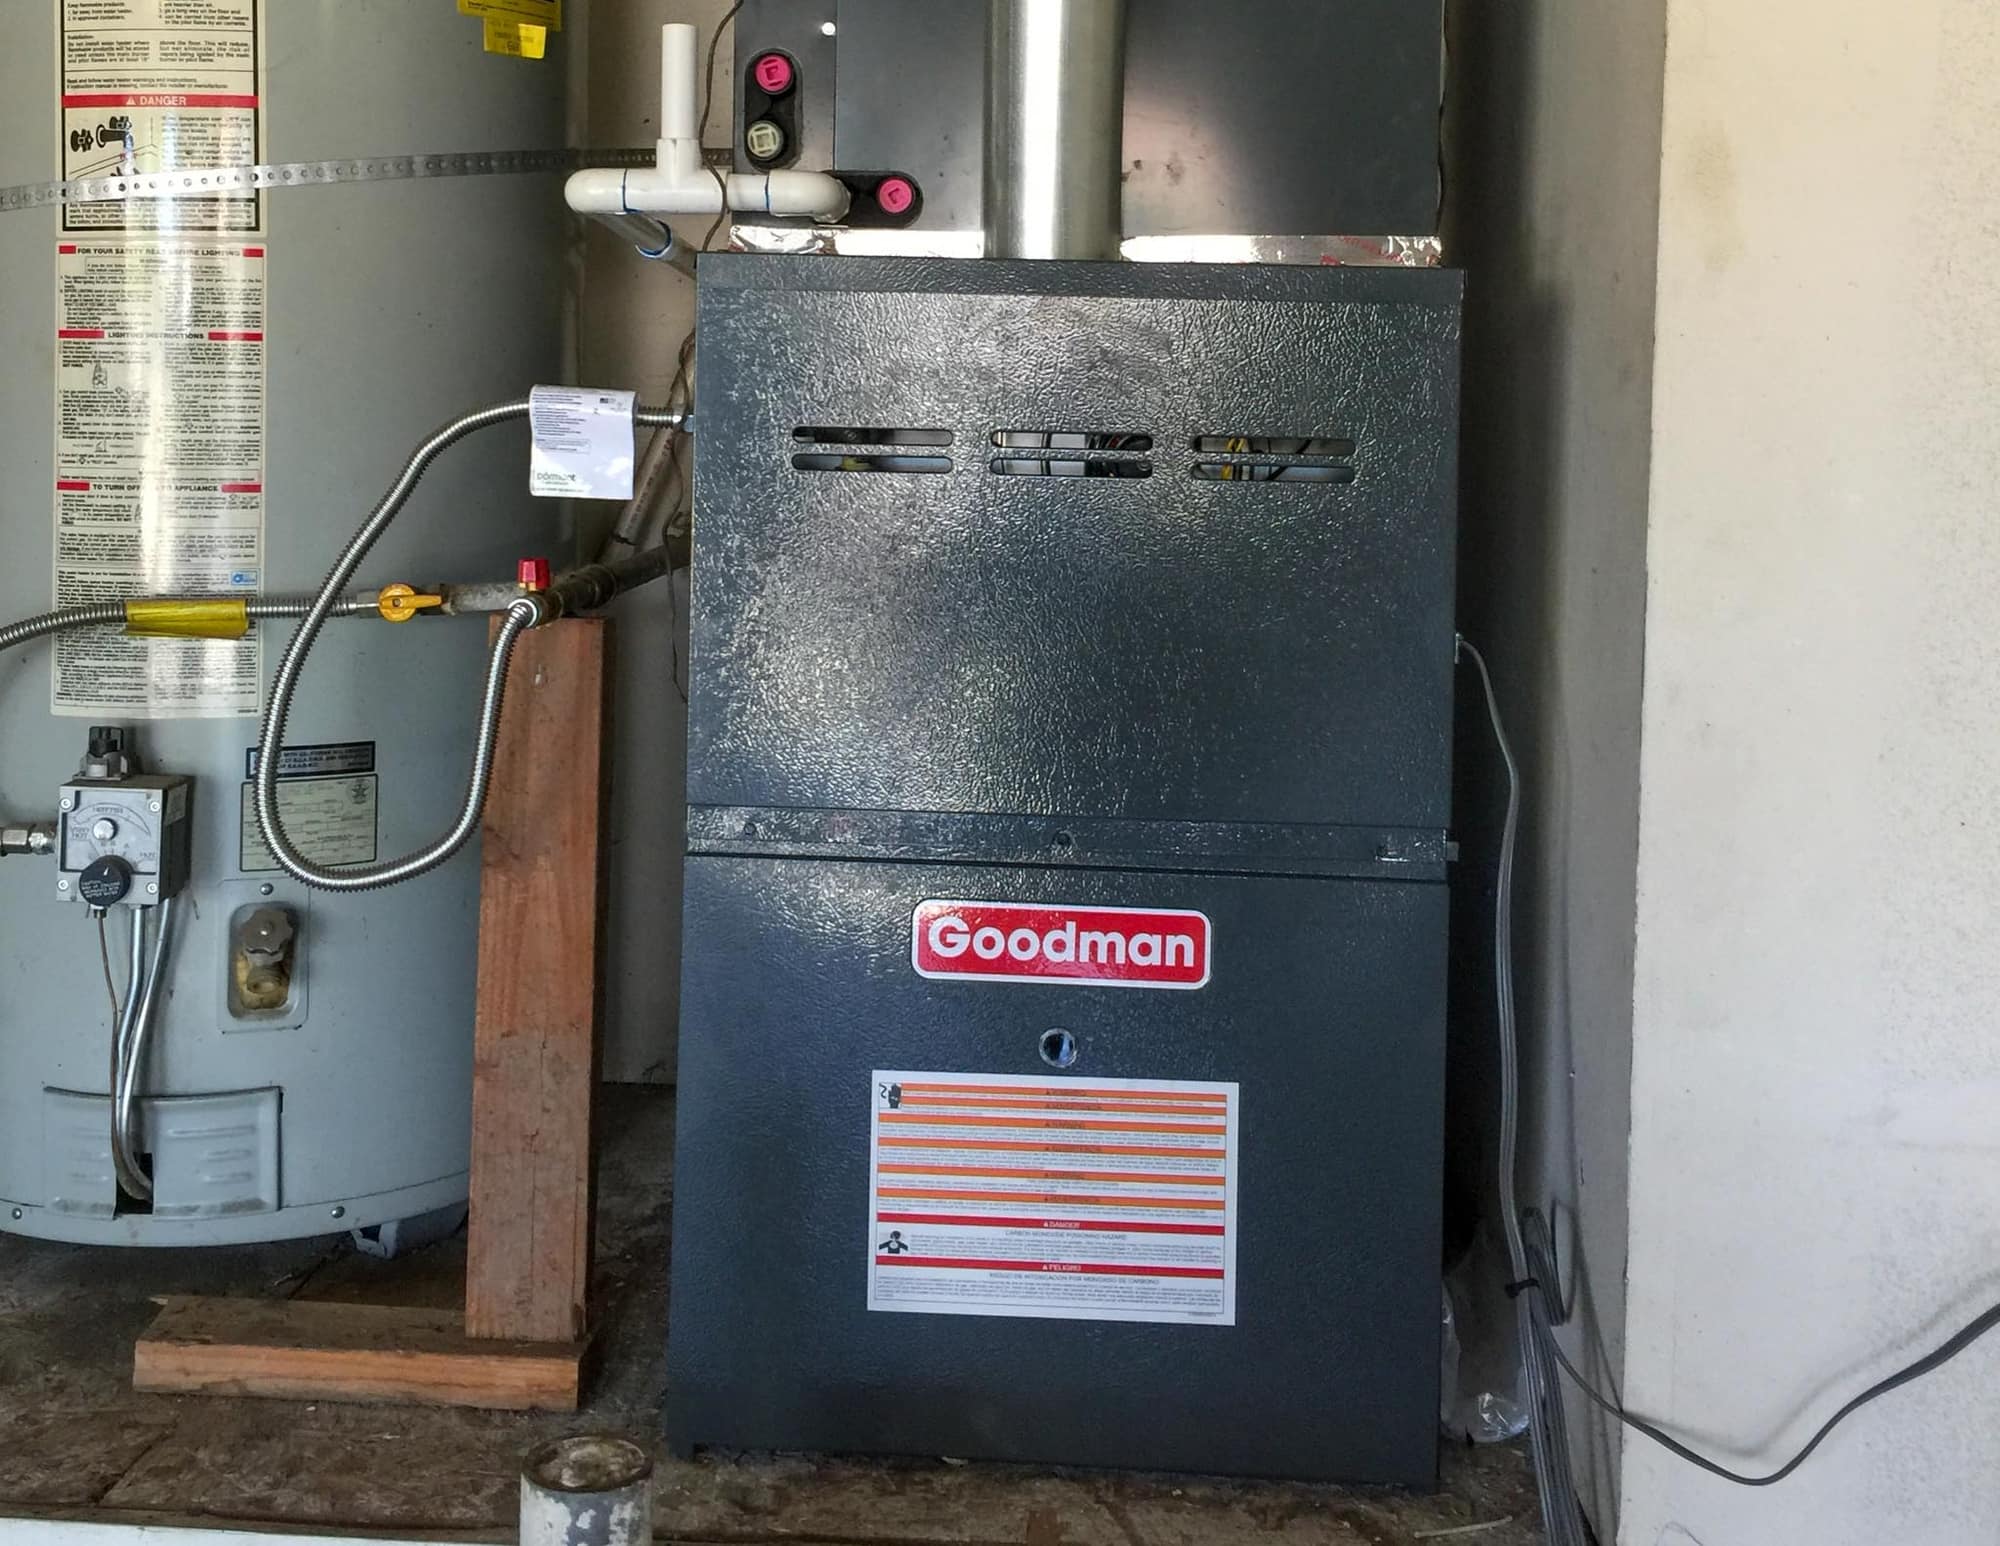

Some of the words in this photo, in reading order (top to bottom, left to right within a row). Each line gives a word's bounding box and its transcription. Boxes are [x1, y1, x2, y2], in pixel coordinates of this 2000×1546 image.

[140, 96, 186, 106] DANGER
[146, 332, 204, 340] INSTRUCTIONS
[928, 916, 1195, 968] Goodman
